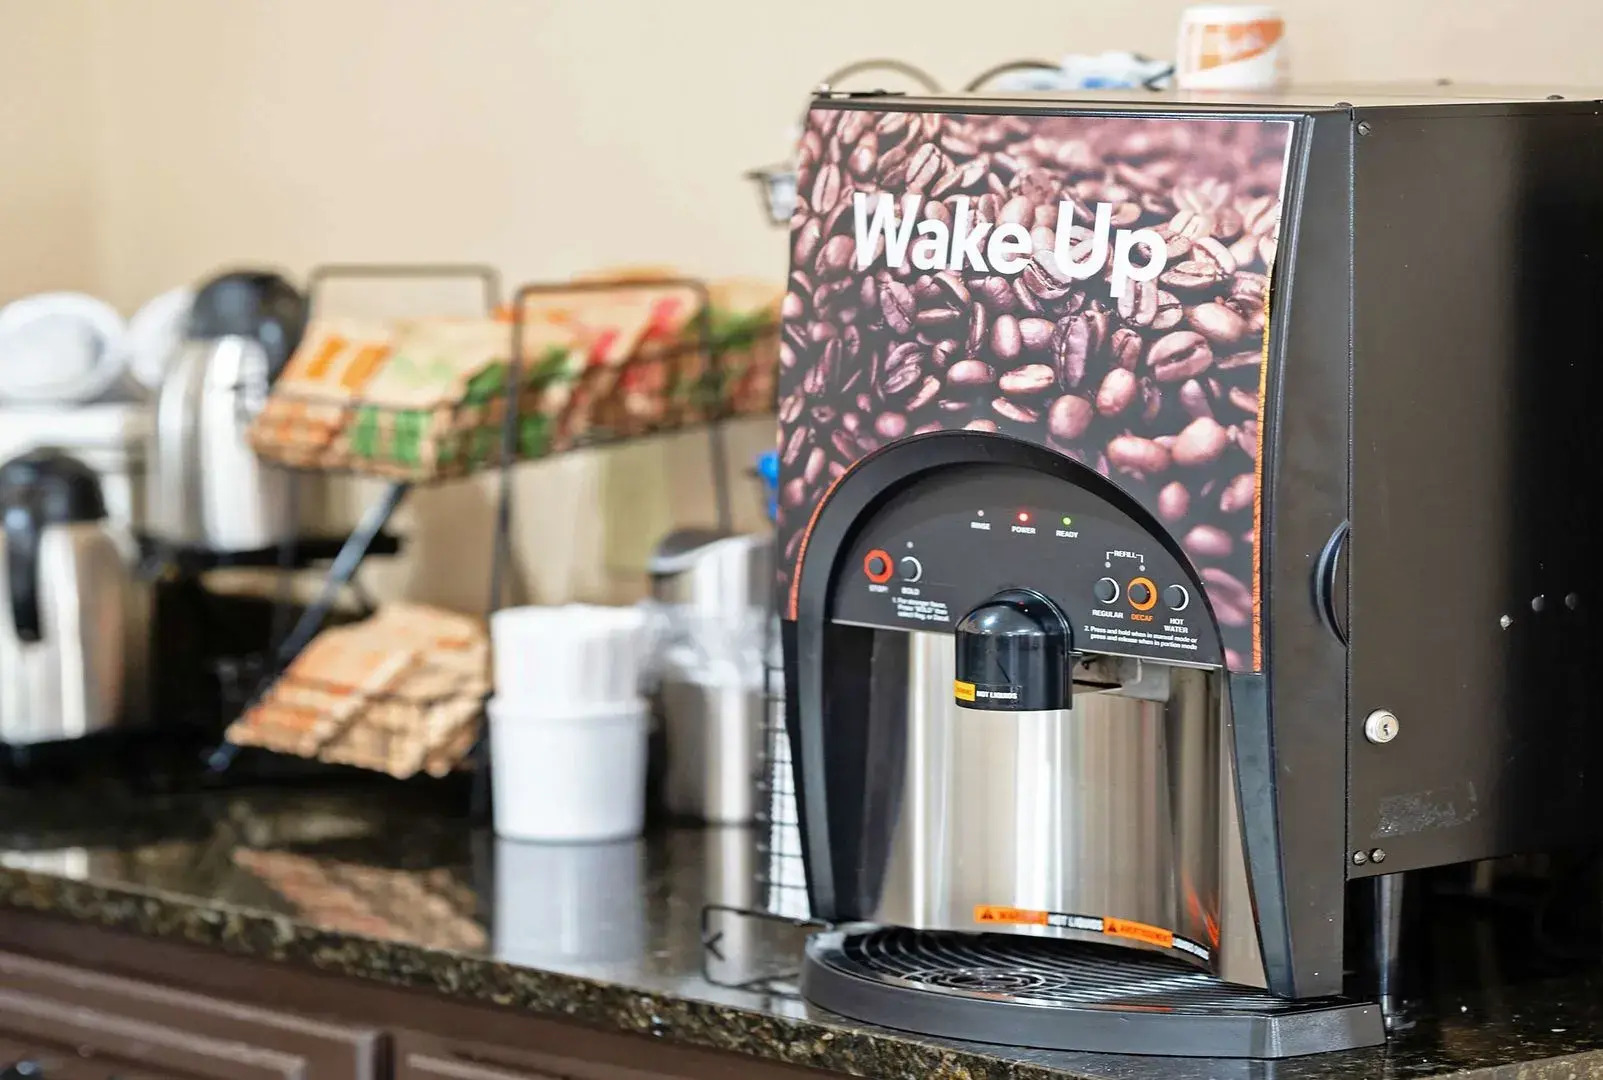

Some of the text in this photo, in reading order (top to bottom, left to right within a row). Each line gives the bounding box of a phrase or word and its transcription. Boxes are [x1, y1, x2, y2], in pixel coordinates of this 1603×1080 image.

[854, 192, 1167, 298] Wake Up
[1011, 525, 1036, 534] POWER
[1056, 530, 1079, 538] READY
[1114, 550, 1137, 558] REFILL
[1092, 609, 1124, 619] REGULAR
[1131, 613, 1153, 621] DECAF
[1090, 626, 1106, 634] Press
[1131, 630, 1146, 638] when
[1163, 625, 1188, 633] WATER
[1160, 641, 1180, 649] portion
